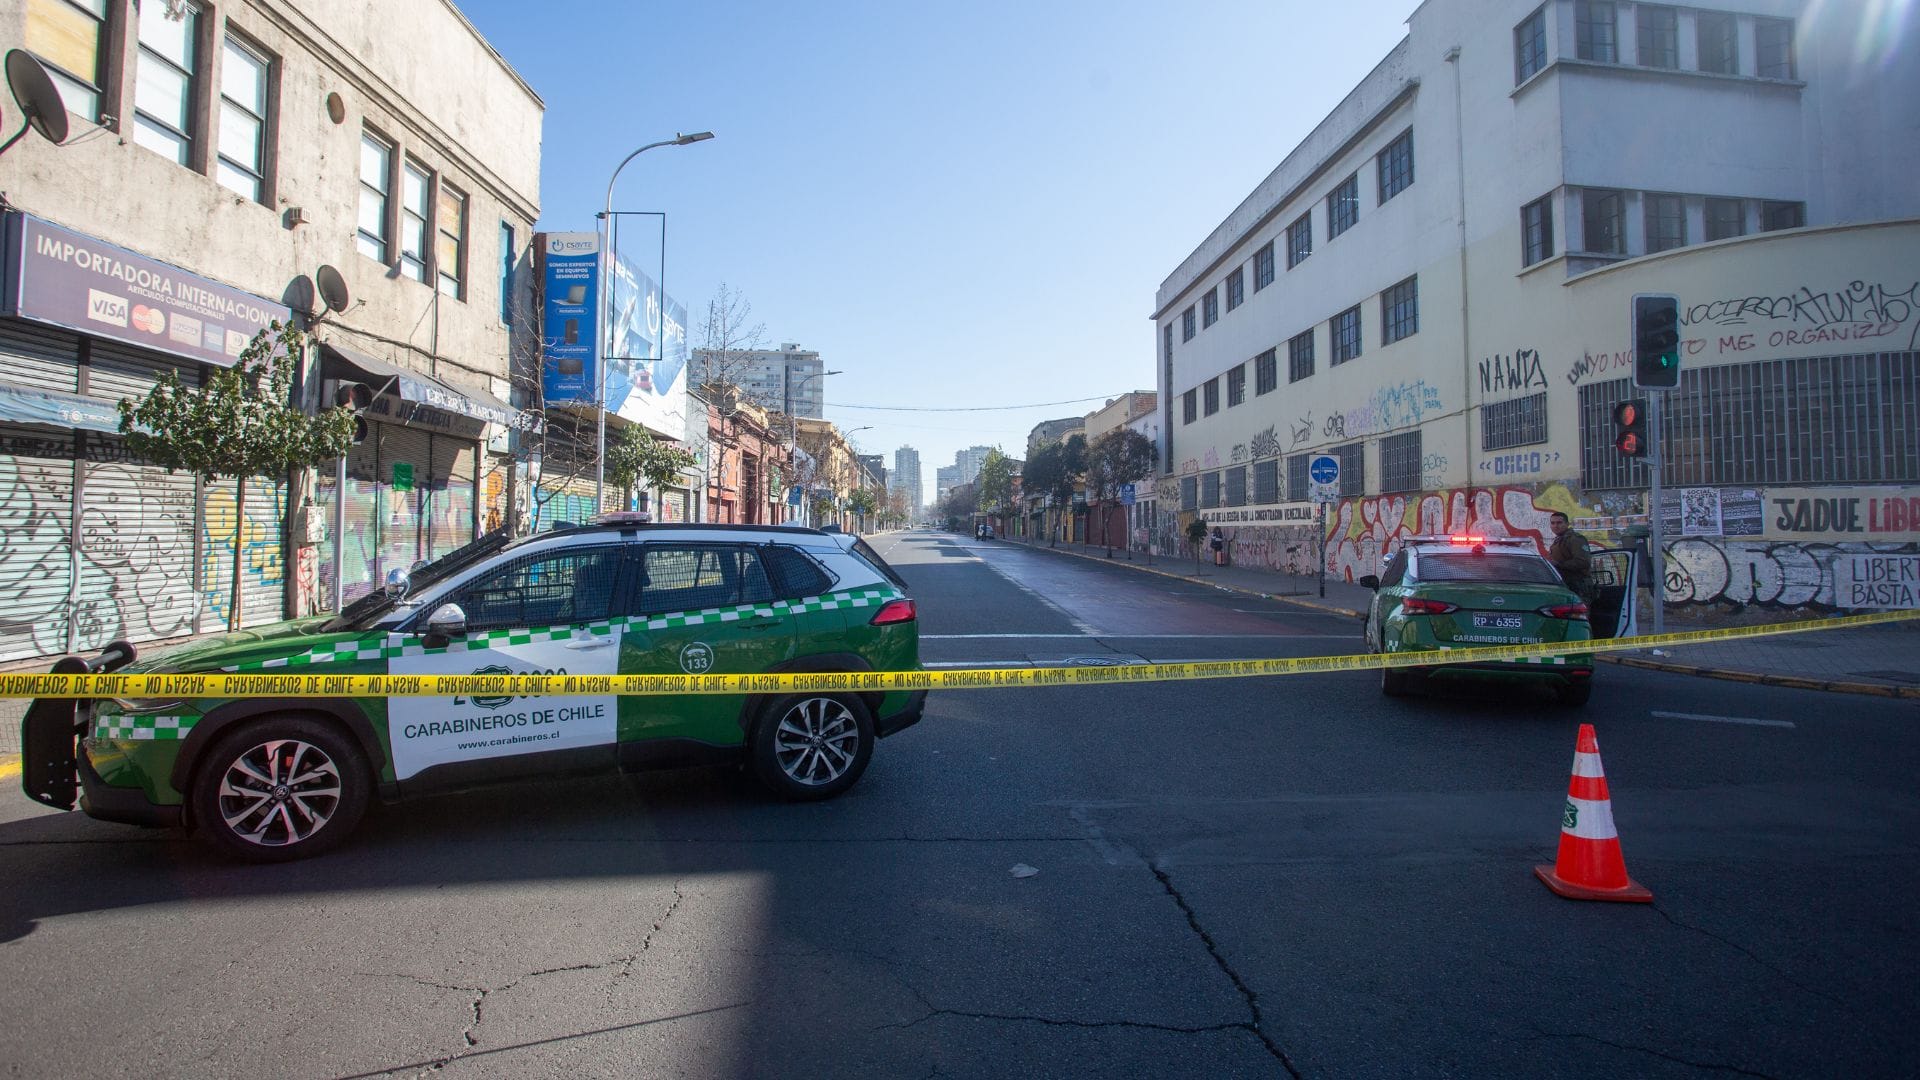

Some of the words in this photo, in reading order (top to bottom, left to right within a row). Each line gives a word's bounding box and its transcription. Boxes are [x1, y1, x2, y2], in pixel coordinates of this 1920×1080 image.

[36, 235, 173, 295] IMPORTADORA
[92, 298, 126, 320] VISA
[128, 285, 165, 304] ARTICULOS
[166, 297, 226, 321] COMPUTACIONALES
[1590, 353, 1608, 377] YO
[1720, 334, 1756, 354] ME
[1772, 498, 1864, 533] JADUE
[1852, 584, 1914, 606] BASTA
[1474, 617, 1487, 626] RP
[1496, 618, 1521, 627] 6355
[1453, 634, 1508, 644] CARABINEROS
[1510, 636, 1521, 644] DE
[687, 657, 708, 670] 133
[404, 711, 528, 739] CARABINEROS
[532, 708, 554, 725] DE
[558, 704, 605, 722] CHILE
[458, 731, 560, 750] www.carabineros.cl
